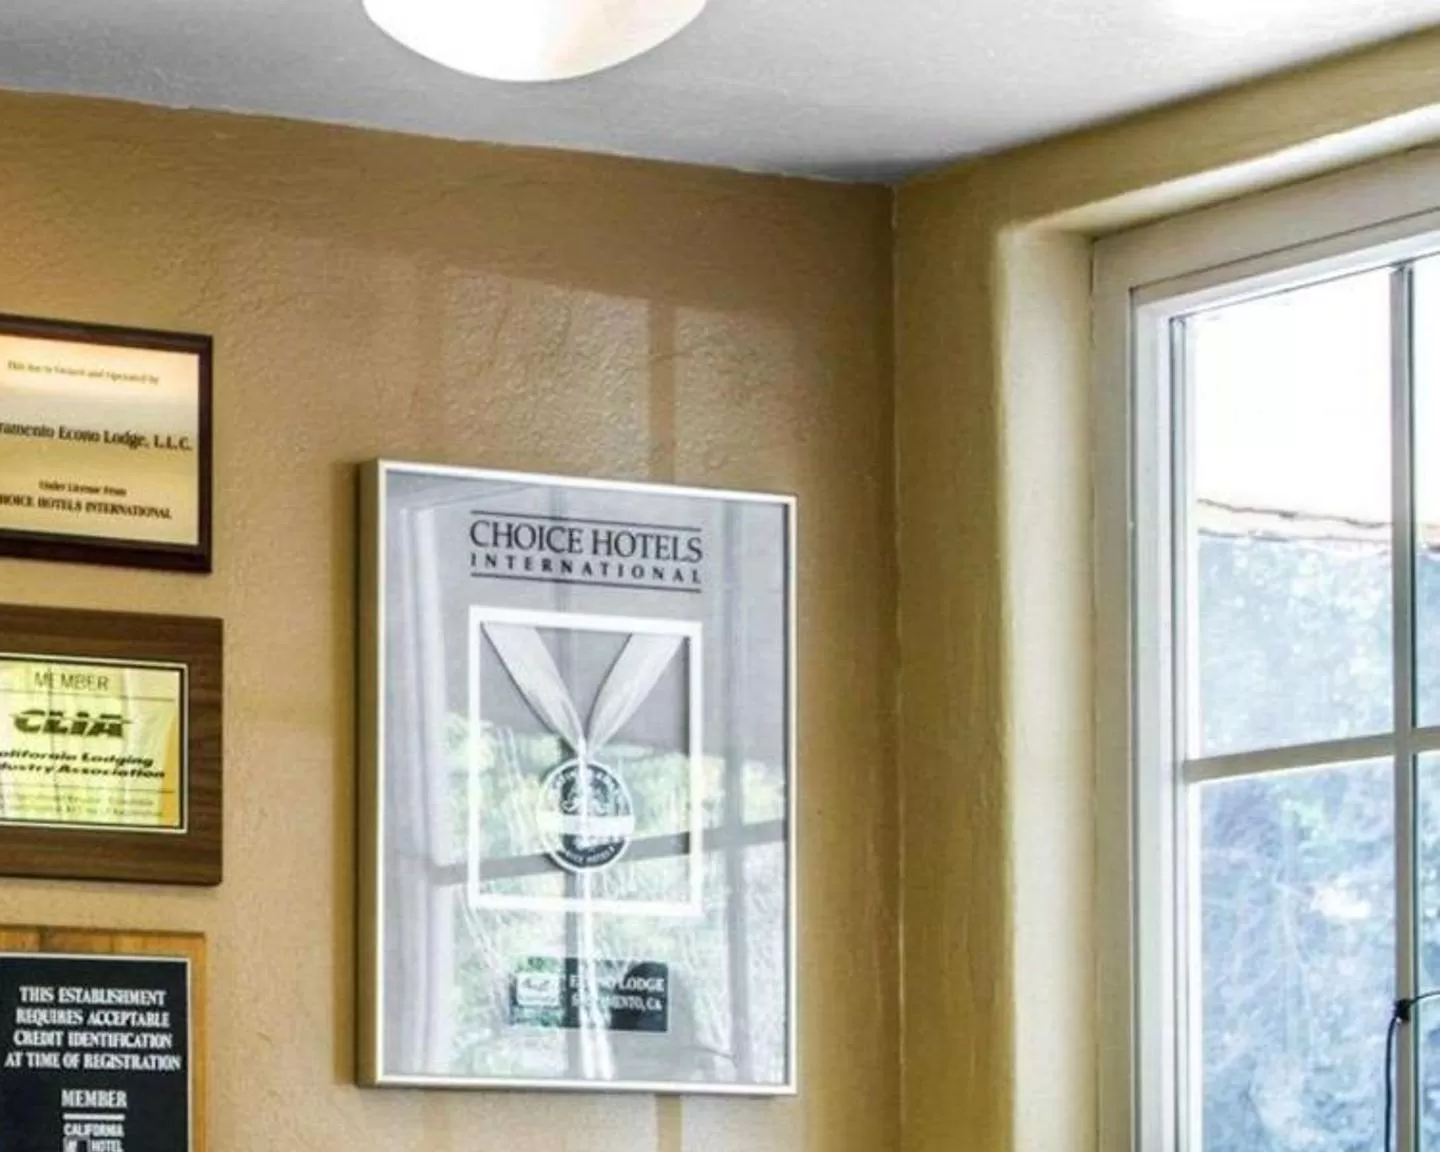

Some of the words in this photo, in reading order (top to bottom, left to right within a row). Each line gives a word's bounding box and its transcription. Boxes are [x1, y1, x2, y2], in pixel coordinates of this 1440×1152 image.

[59, 425, 101, 442] Econo
[37, 496, 82, 513] HOTELS
[85, 499, 173, 519] INTERNATIONAL
[470, 519, 584, 554] CHOICE
[592, 528, 703, 563] HOTELS
[471, 552, 701, 583] INTERNATIONAL
[35, 671, 109, 692] MEMBER
[81, 751, 154, 767] Lodging
[58, 763, 165, 778] Association
[618, 975, 665, 991] LODGE
[19, 986, 54, 1003] THIS
[58, 986, 166, 1006] ESTABLISHMENT
[16, 1007, 83, 1026] REQUIRES
[87, 1009, 170, 1027] ACCEPTABLE
[13, 1029, 64, 1046] CREDIT
[67, 1031, 173, 1049] IDENTIFICATION
[4, 1051, 24, 1068] AT
[25, 1052, 61, 1068] TIME
[62, 1053, 80, 1069] OF
[83, 1053, 182, 1070] REGISTRATION
[61, 1089, 128, 1108] MEMBER
[63, 1122, 124, 1137] CALIFORNIA
